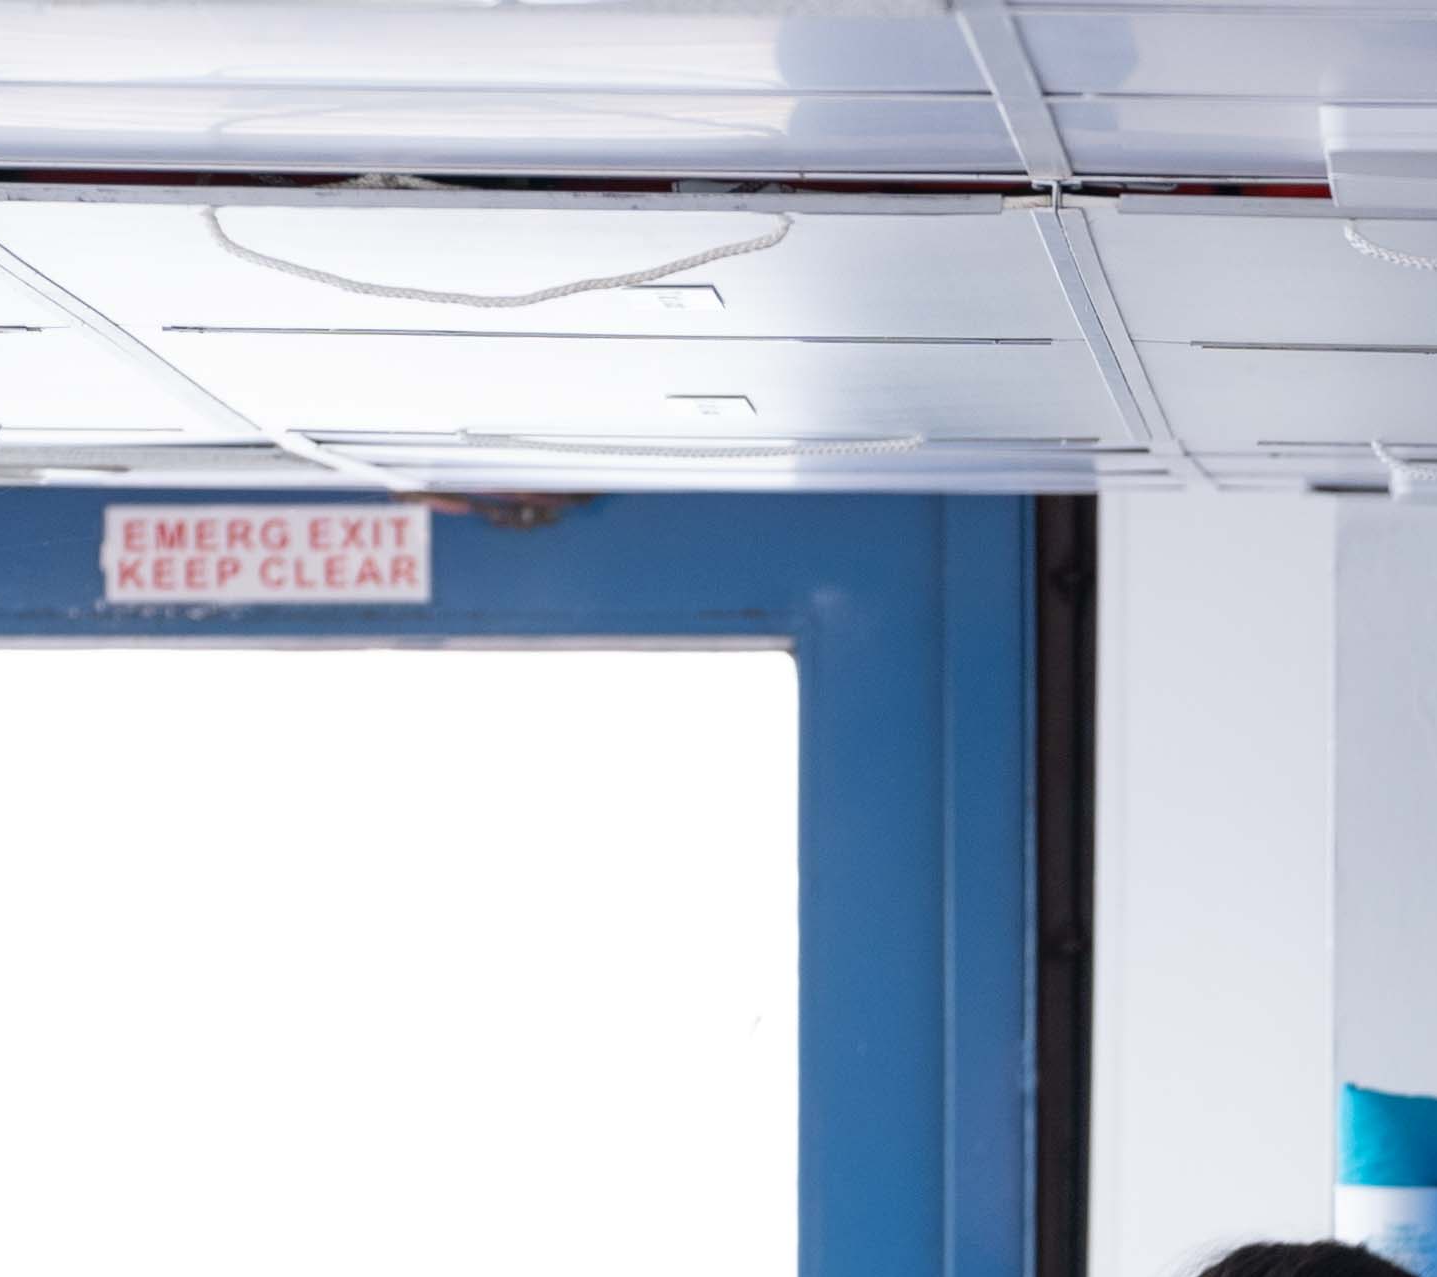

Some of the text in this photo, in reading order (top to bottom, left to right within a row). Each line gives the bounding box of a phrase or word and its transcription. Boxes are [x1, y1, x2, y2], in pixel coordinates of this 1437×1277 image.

[122, 516, 412, 552] EMERG EXIT
[116, 554, 420, 591] KEEP CLEAR
